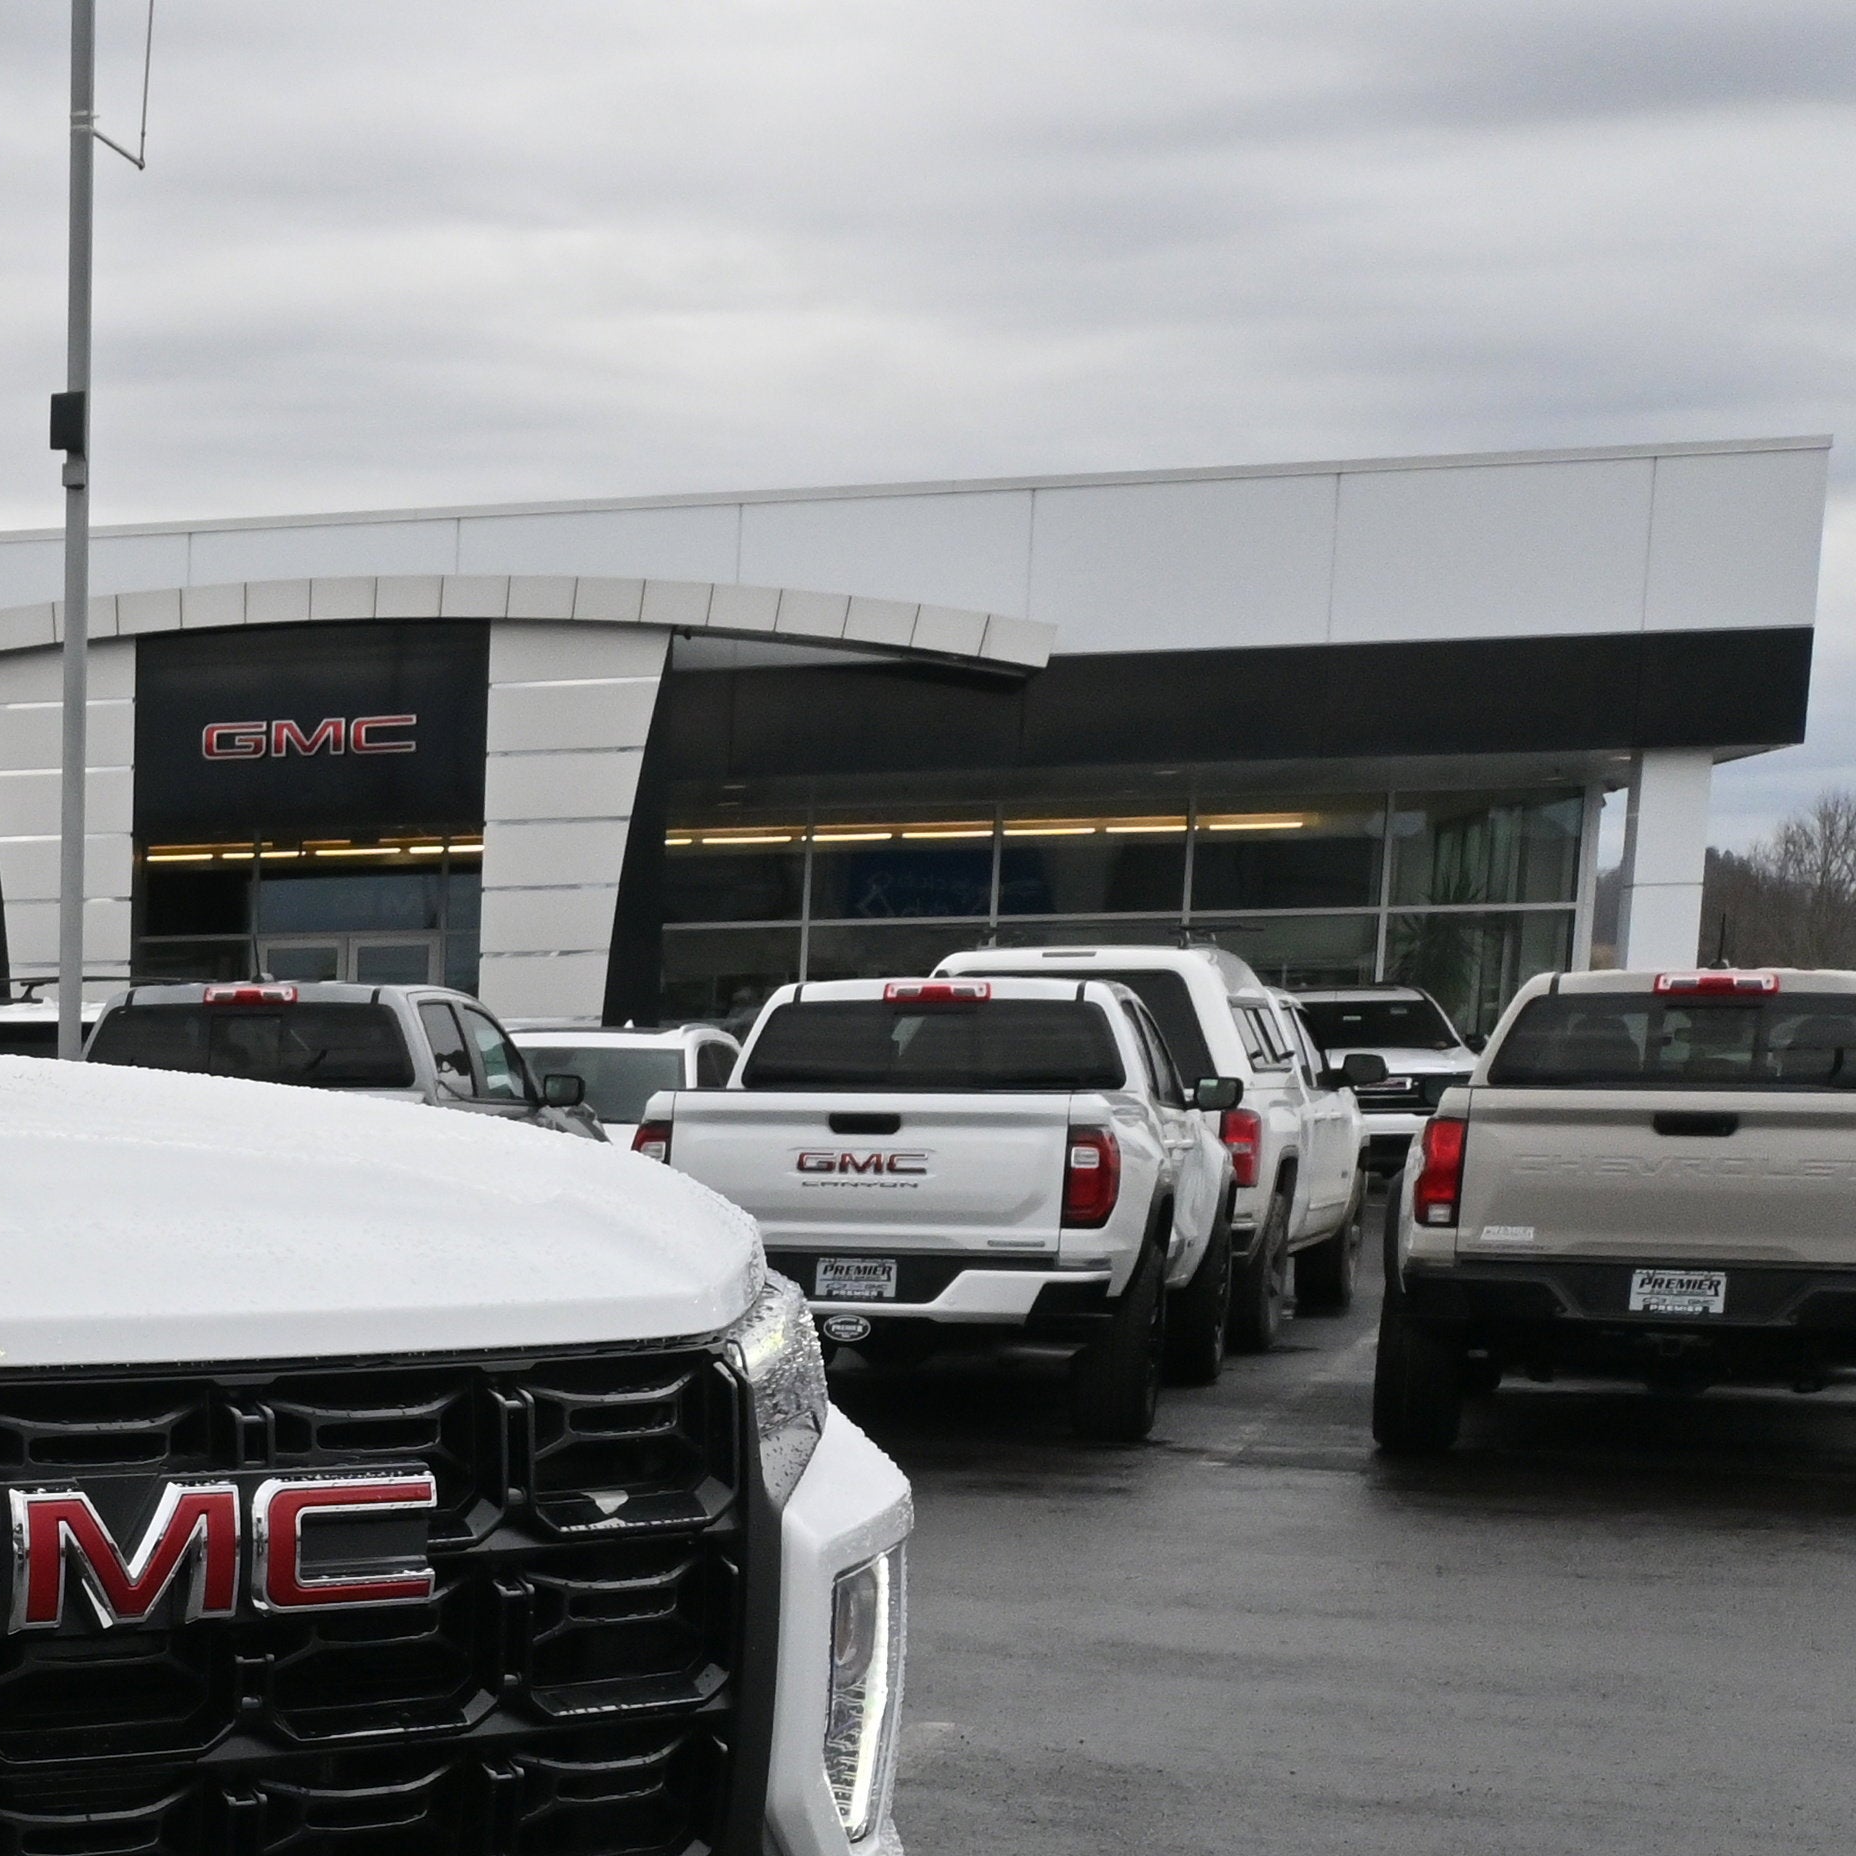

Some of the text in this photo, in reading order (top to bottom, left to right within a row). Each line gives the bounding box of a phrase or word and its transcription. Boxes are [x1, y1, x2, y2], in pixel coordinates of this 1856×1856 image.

[202, 714, 417, 760] GMC
[796, 1152, 928, 1175] GMC
[822, 1265, 892, 1282] PREMIER
[1639, 1277, 1721, 1297] PREMIER
